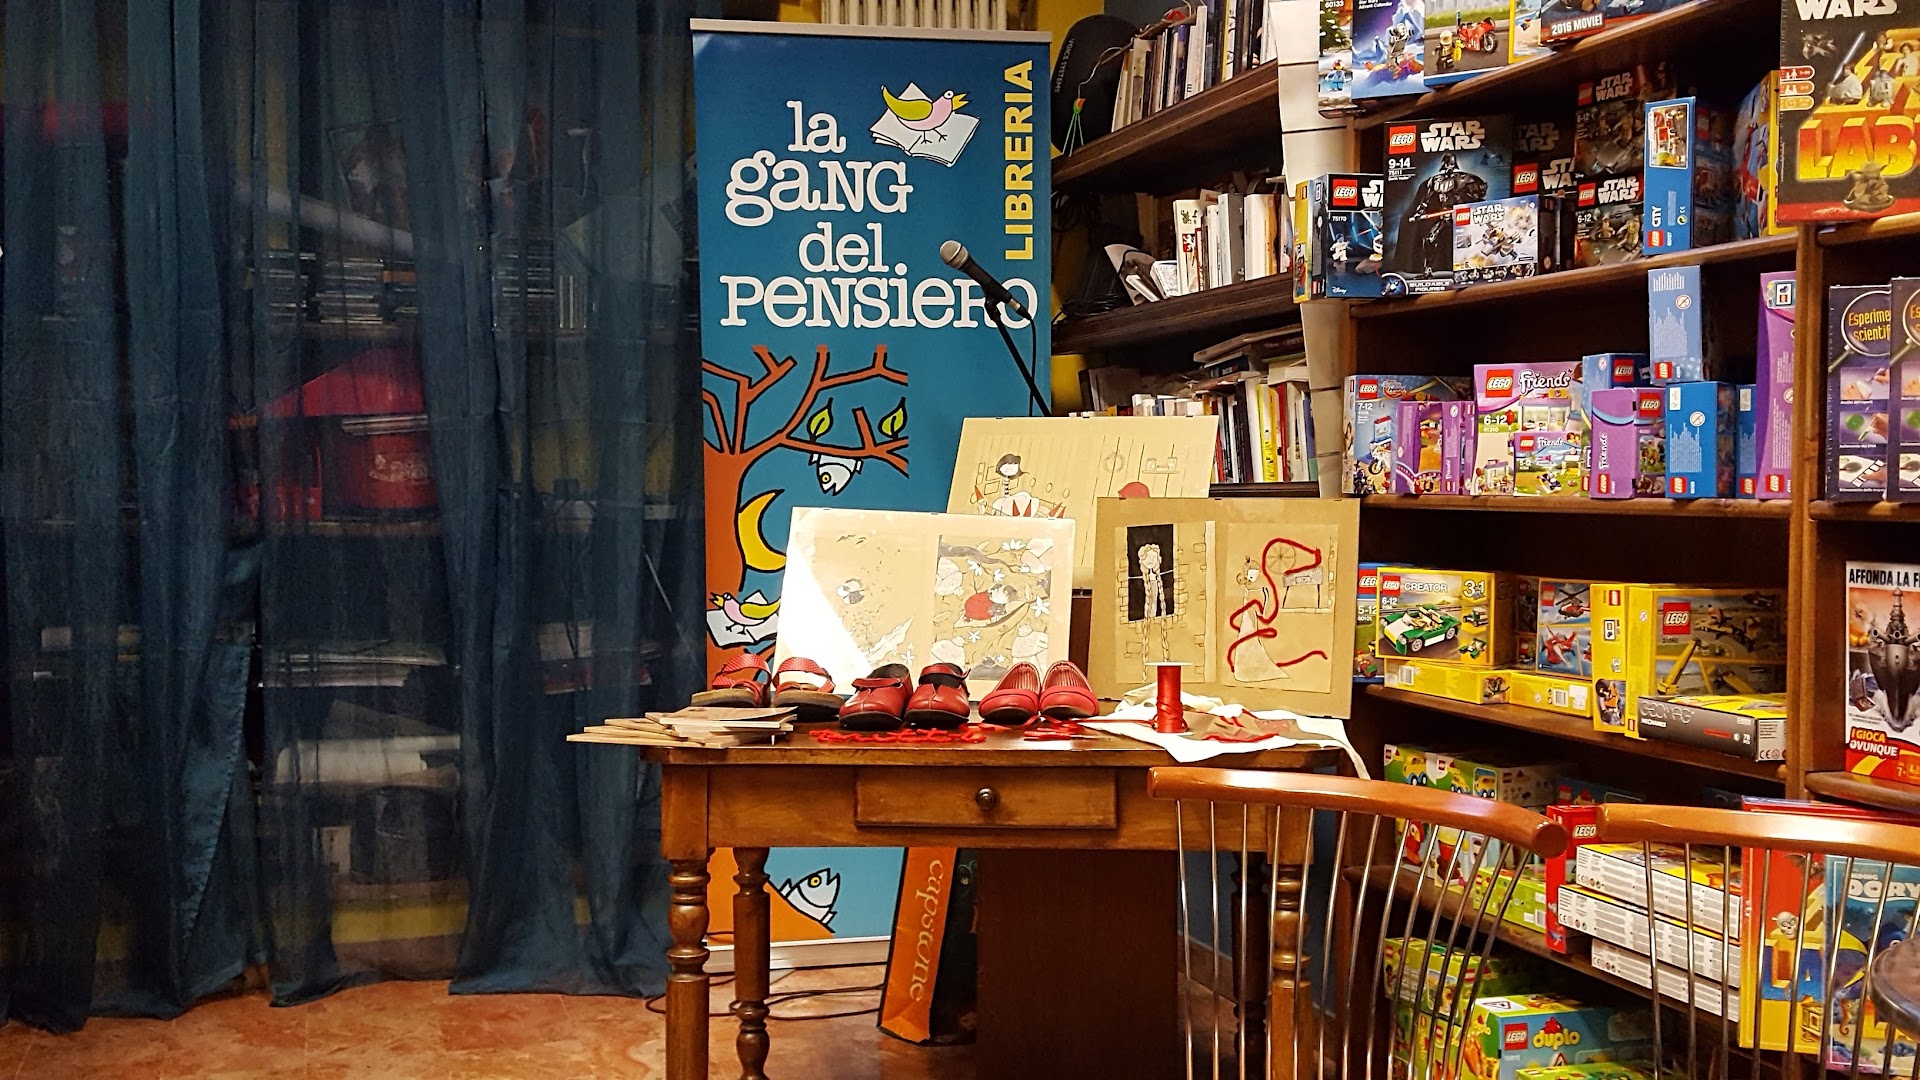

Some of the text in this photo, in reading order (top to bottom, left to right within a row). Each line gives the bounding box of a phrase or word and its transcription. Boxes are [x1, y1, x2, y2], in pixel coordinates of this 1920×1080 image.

[1552, 13, 1603, 35] 2016 MOVIE!
[1596, 72, 1633, 90] STAR
[1596, 83, 1633, 102] WARS
[786, 100, 846, 153] la
[1421, 120, 1485, 138] STAR
[1390, 133, 1416, 147] LEGO
[1421, 135, 1485, 152] WARS
[1798, 119, 1920, 179] LAB
[1004, 60, 1033, 260] LIBRERIA
[1389, 157, 1410, 169] 9-14
[1515, 171, 1538, 186] LEGO
[1598, 176, 1639, 192] STAR
[1334, 186, 1357, 199] LEGO
[1598, 187, 1639, 204] WARS
[1473, 204, 1504, 215] STAR
[1473, 212, 1504, 224] WARS
[1652, 206, 1661, 227] CITY
[1577, 214, 1592, 223] 6-12
[799, 222, 889, 273] del
[1848, 309, 1891, 327] Esperime
[1853, 324, 1891, 341] scientif
[1614, 366, 1633, 376] LEGO
[1358, 384, 1378, 395] LEGO
[1486, 369, 1571, 396] LEGO Friends
[1641, 400, 1660, 410] LEGO
[1484, 415, 1507, 425] 6-12
[1849, 569, 1893, 586] AFFONDA
[1897, 571, 1909, 587] LA
[1404, 582, 1449, 593] CREATOR
[1382, 597, 1397, 605] 6-12
[1664, 612, 1689, 626] LEGO
[1856, 730, 1886, 743] GIOCA
[1573, 825, 1597, 838] LEGO
[1849, 879, 1920, 898] DORY
[910, 860, 944, 1002] capstone
[1505, 1027, 1580, 1050] LEGO duplo
